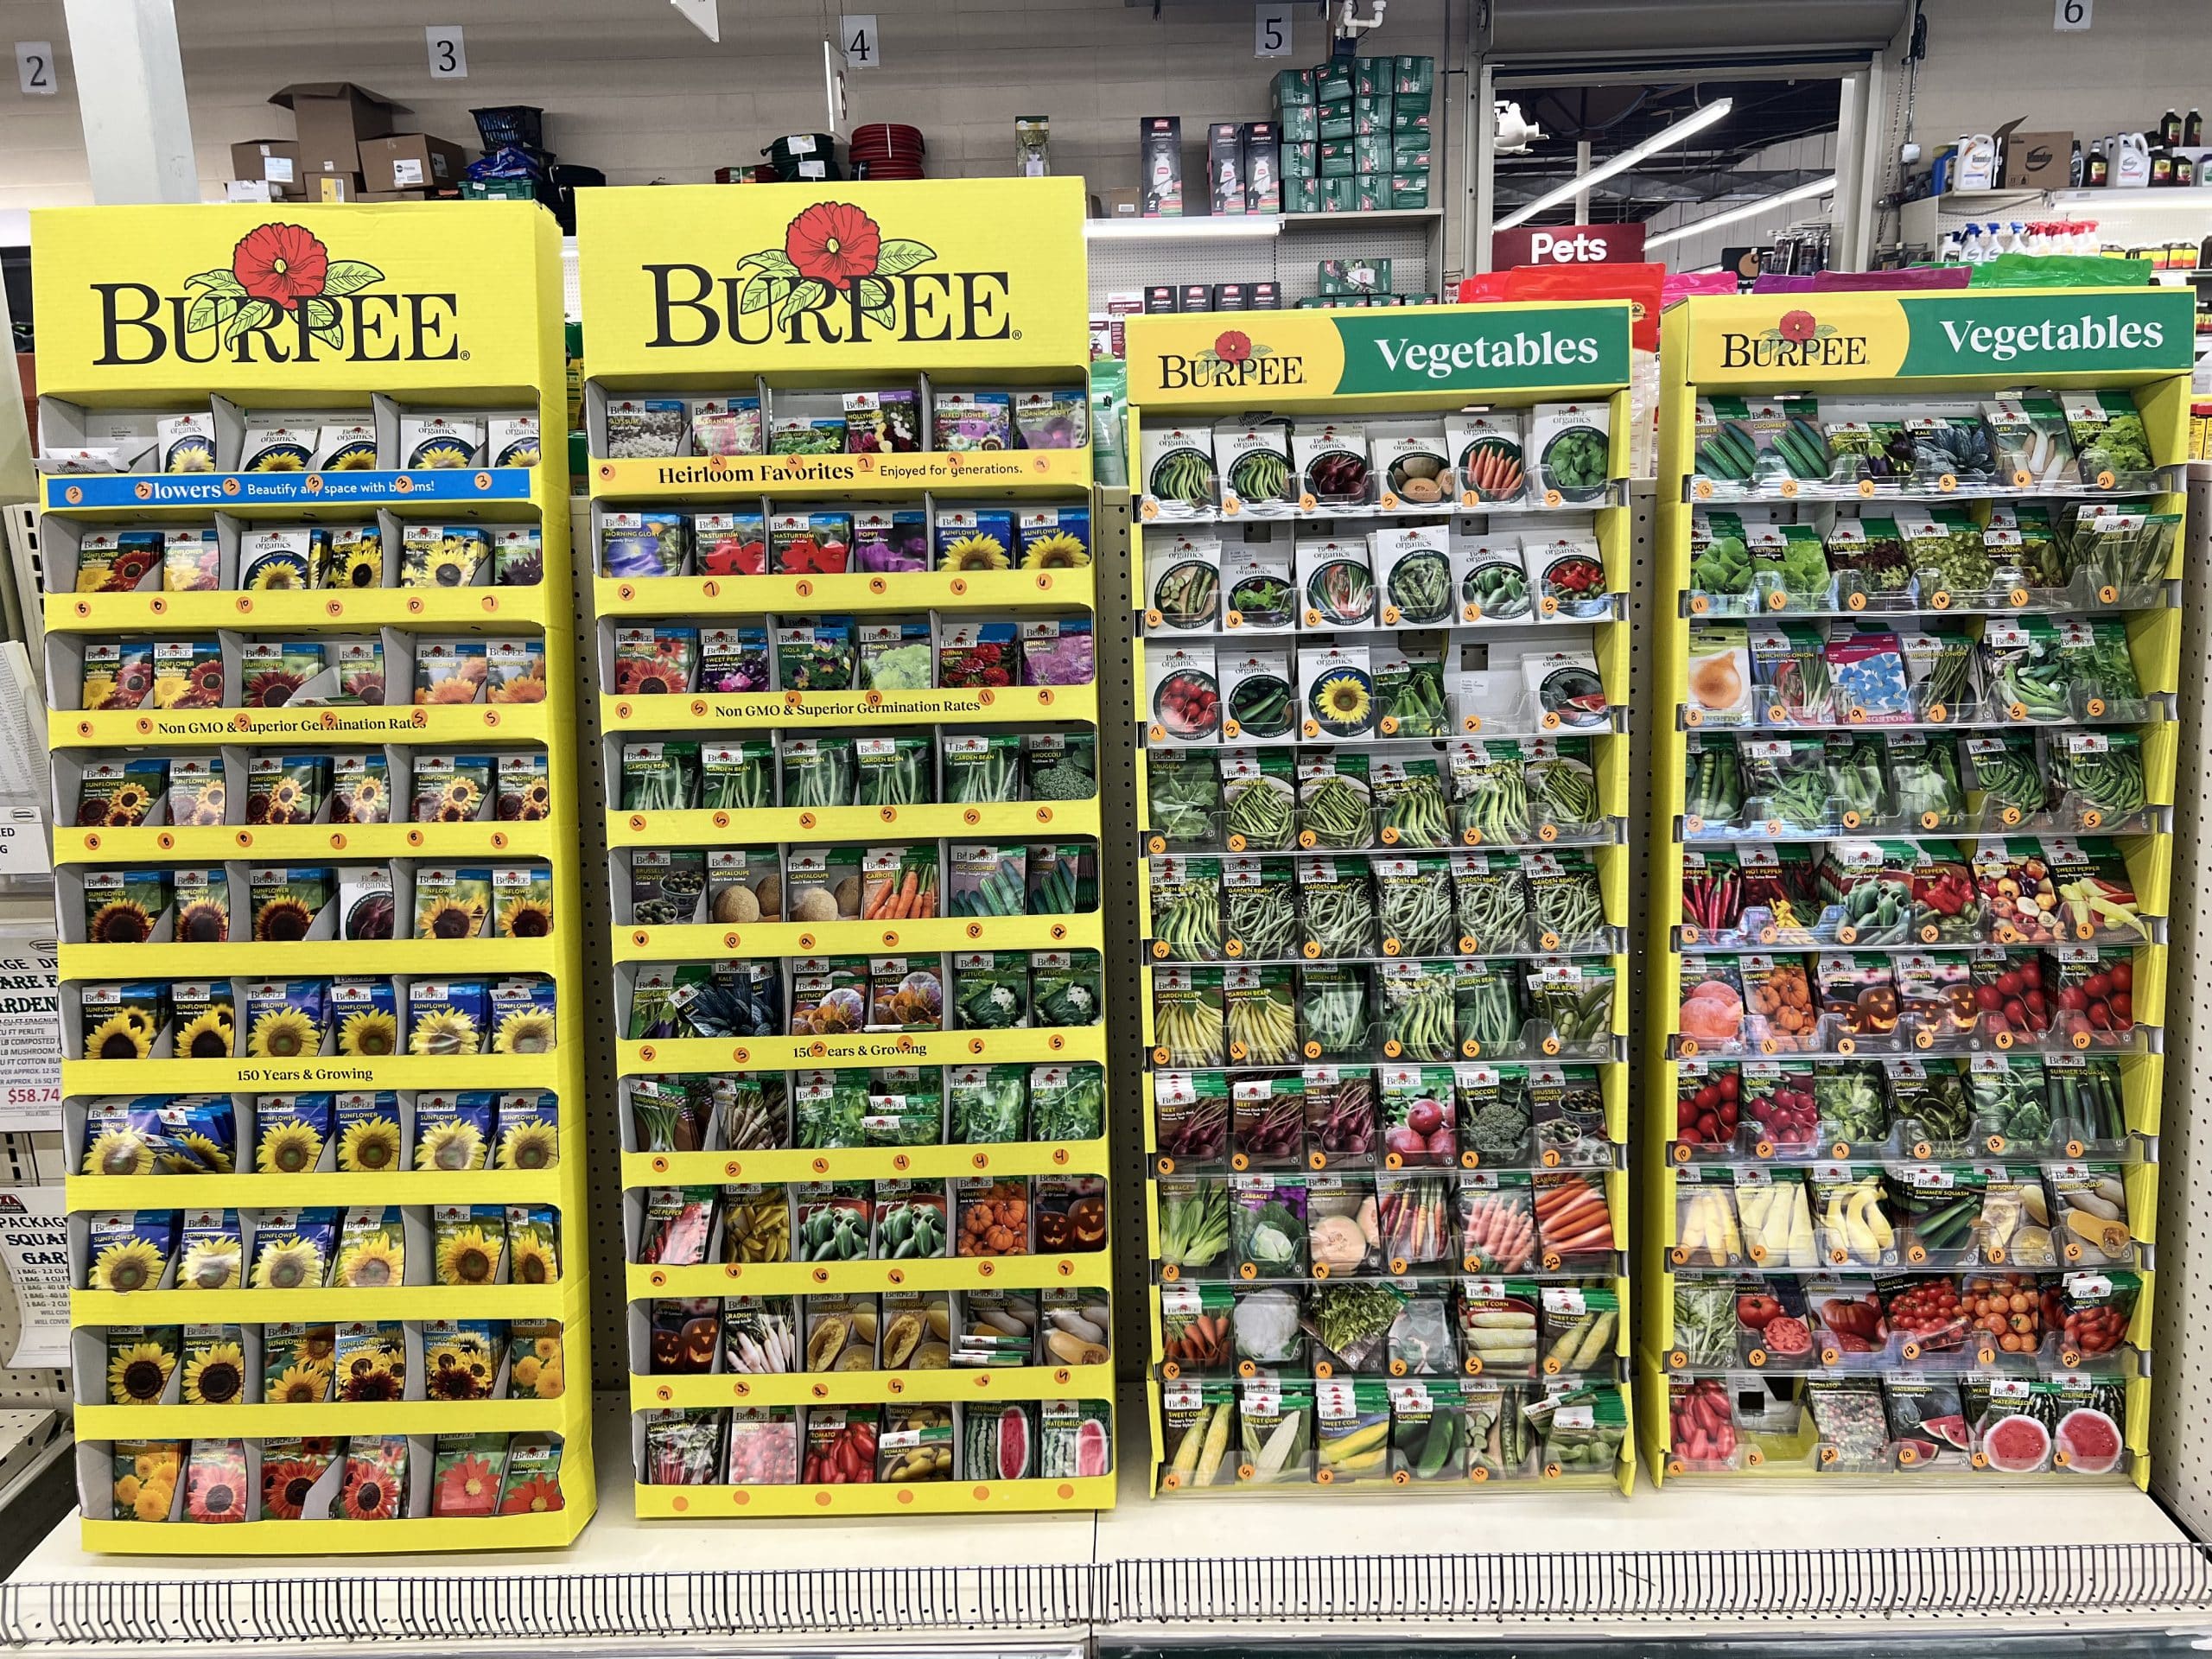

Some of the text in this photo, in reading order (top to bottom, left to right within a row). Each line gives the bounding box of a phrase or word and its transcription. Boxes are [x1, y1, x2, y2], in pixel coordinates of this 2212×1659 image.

[2064, 0, 2083, 23] 6
[1264, 17, 1282, 49] 5
[850, 29, 870, 60] 4
[438, 40, 457, 72] 3
[27, 56, 47, 86] 2
[1531, 233, 1607, 264] Pets
[643, 264, 1011, 346] BURPEE
[91, 283, 459, 365] BURPEE
[1940, 315, 2164, 359] Vegetables
[1374, 330, 1599, 378] Vegetables
[1720, 334, 1867, 367] BURPEE
[1159, 354, 1302, 390] BURPEE
[658, 462, 854, 484] Heirloom Favorites
[880, 464, 1022, 479] Enjoyed for generations.
[151, 482, 221, 499] lowers
[248, 485, 296, 495] Beautify
[325, 484, 357, 499] space
[360, 482, 385, 493] with
[715, 701, 981, 717] Non GMO & Superior Germination Rates
[158, 722, 185, 734] Non
[189, 722, 223, 733] GMO
[227, 722, 237, 732] &
[242, 720, 298, 734] uperior
[302, 719, 385, 731] Gerination
[10, 1047, 54, 1056] MUSHROOM
[828, 1047, 855, 1058] ears
[858, 1046, 869, 1056] &
[238, 1068, 372, 1082] 150 Years & Growing
[9, 1088, 60, 1104] $58.74
[0, 1217, 67, 1228] PACKAG
[22, 1251, 67, 1265] GAR
